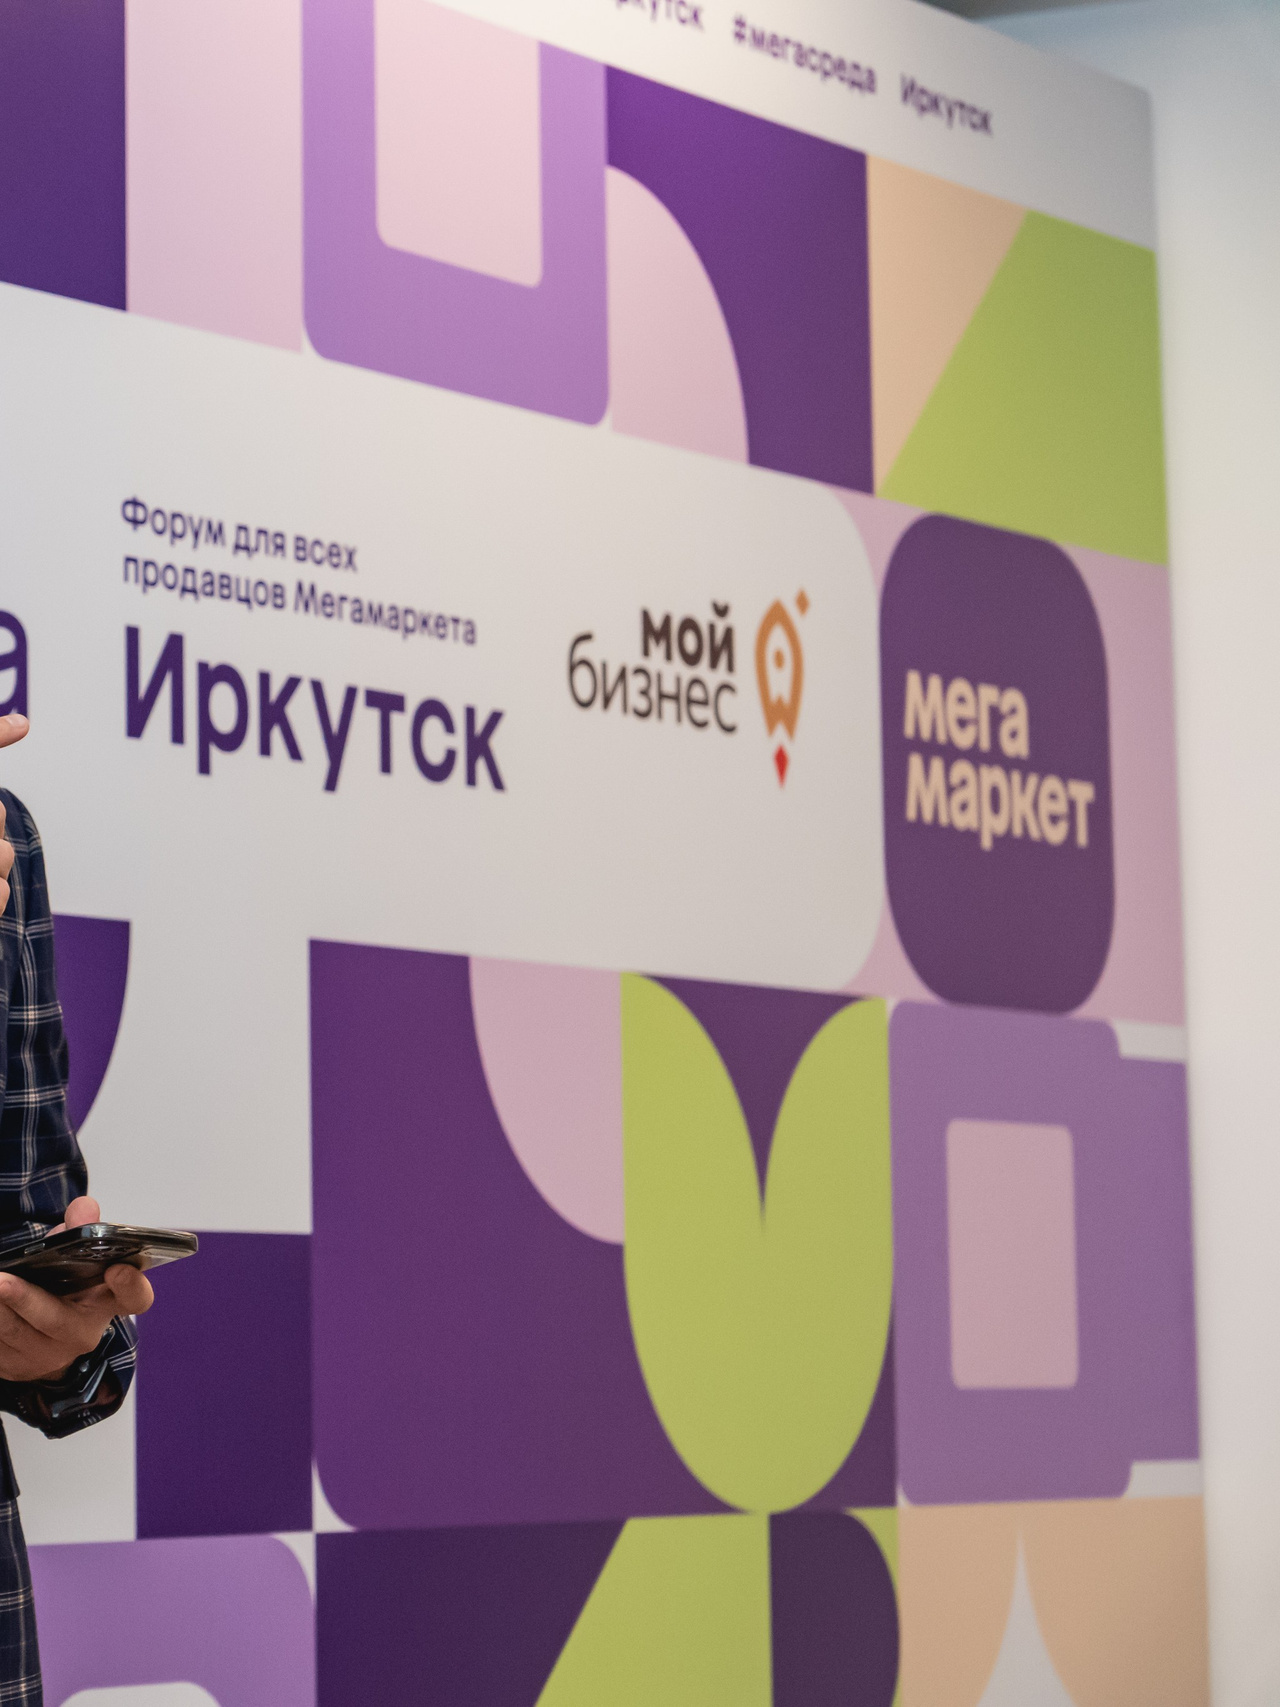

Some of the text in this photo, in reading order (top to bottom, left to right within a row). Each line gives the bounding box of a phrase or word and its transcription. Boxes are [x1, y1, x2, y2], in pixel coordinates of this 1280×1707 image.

[733, 15, 878, 95] #мегасреда
[900, 74, 993, 137] Иркутск
[120, 496, 358, 572] Форум для всех
[123, 555, 477, 646] продавцов Мегамаркета
[641, 600, 735, 674] мой
[124, 624, 507, 794] Иркутск
[567, 632, 738, 735] бизнес
